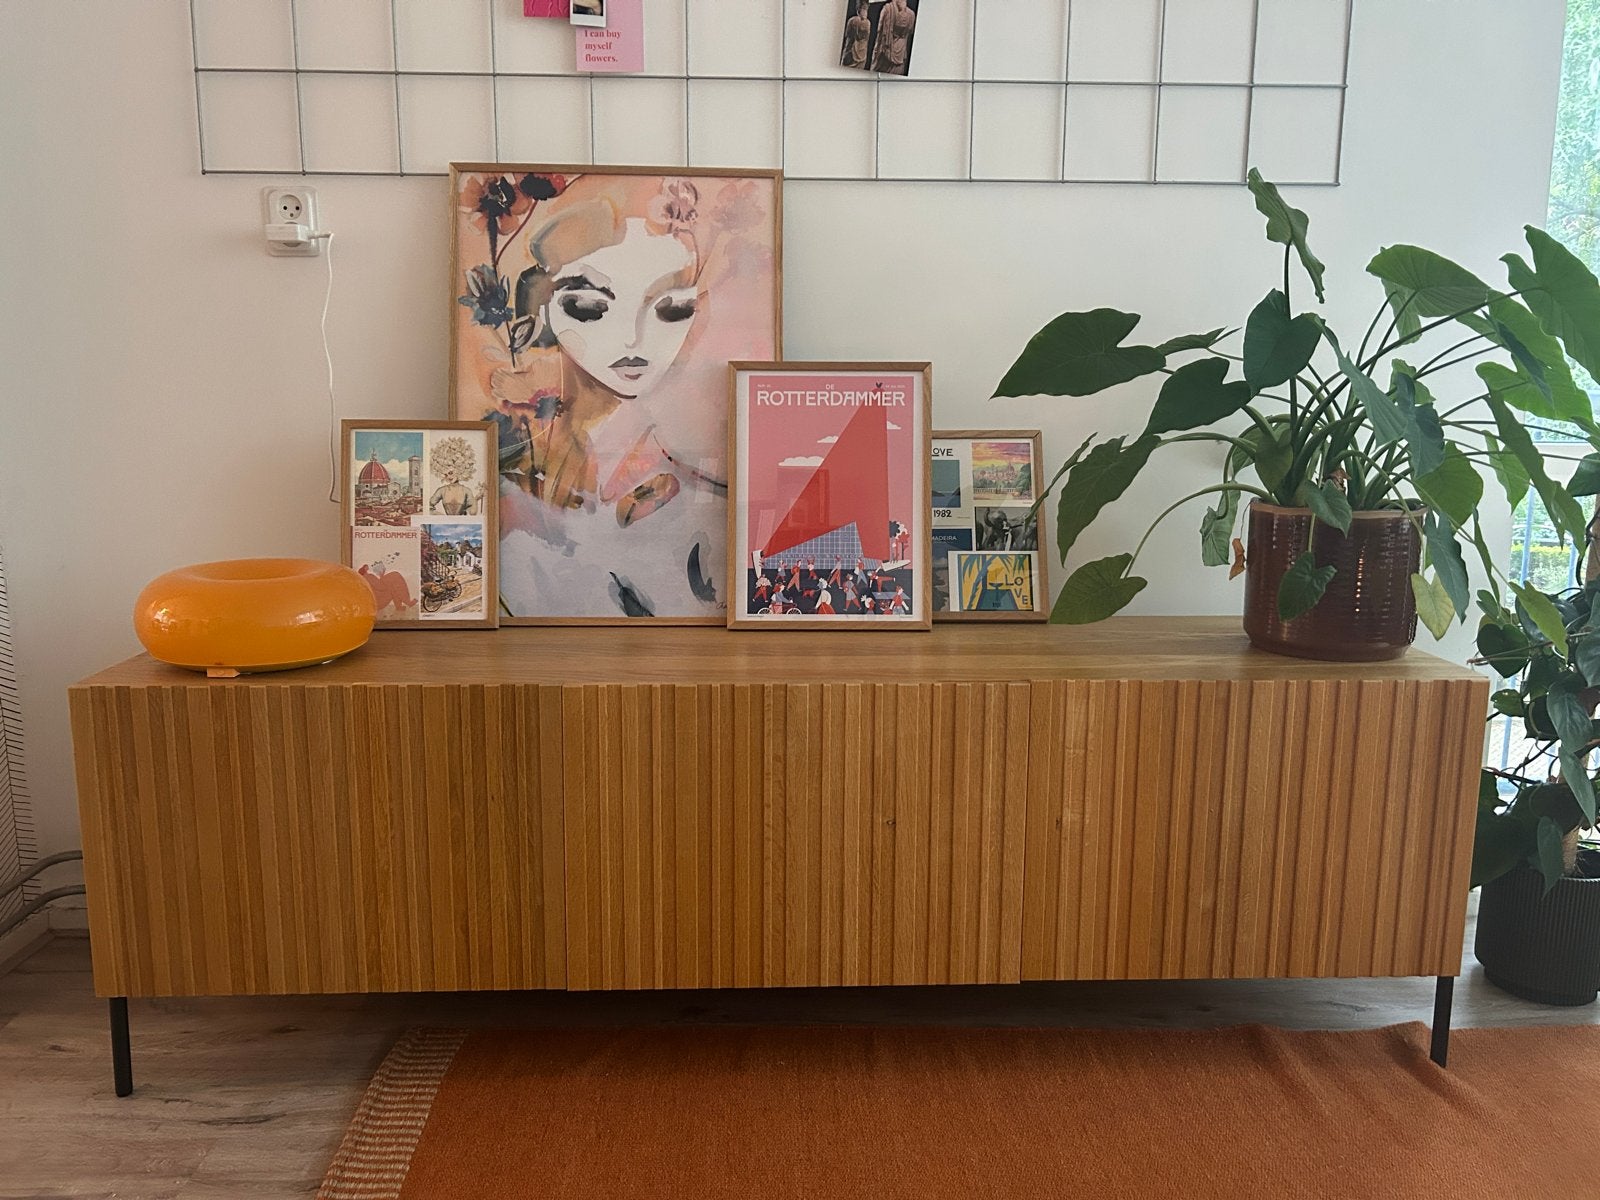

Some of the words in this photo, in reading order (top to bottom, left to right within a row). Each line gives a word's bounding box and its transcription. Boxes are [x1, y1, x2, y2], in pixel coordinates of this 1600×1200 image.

[584, 29, 588, 37] I
[606, 30, 621, 39] buy
[585, 42, 612, 51] myself
[585, 53, 618, 62] flowers.
[757, 390, 906, 407] ROTTERDAMMER
[932, 447, 954, 457] OVE
[933, 510, 952, 518] 1982
[354, 531, 418, 539] ROTTERDAMMER
